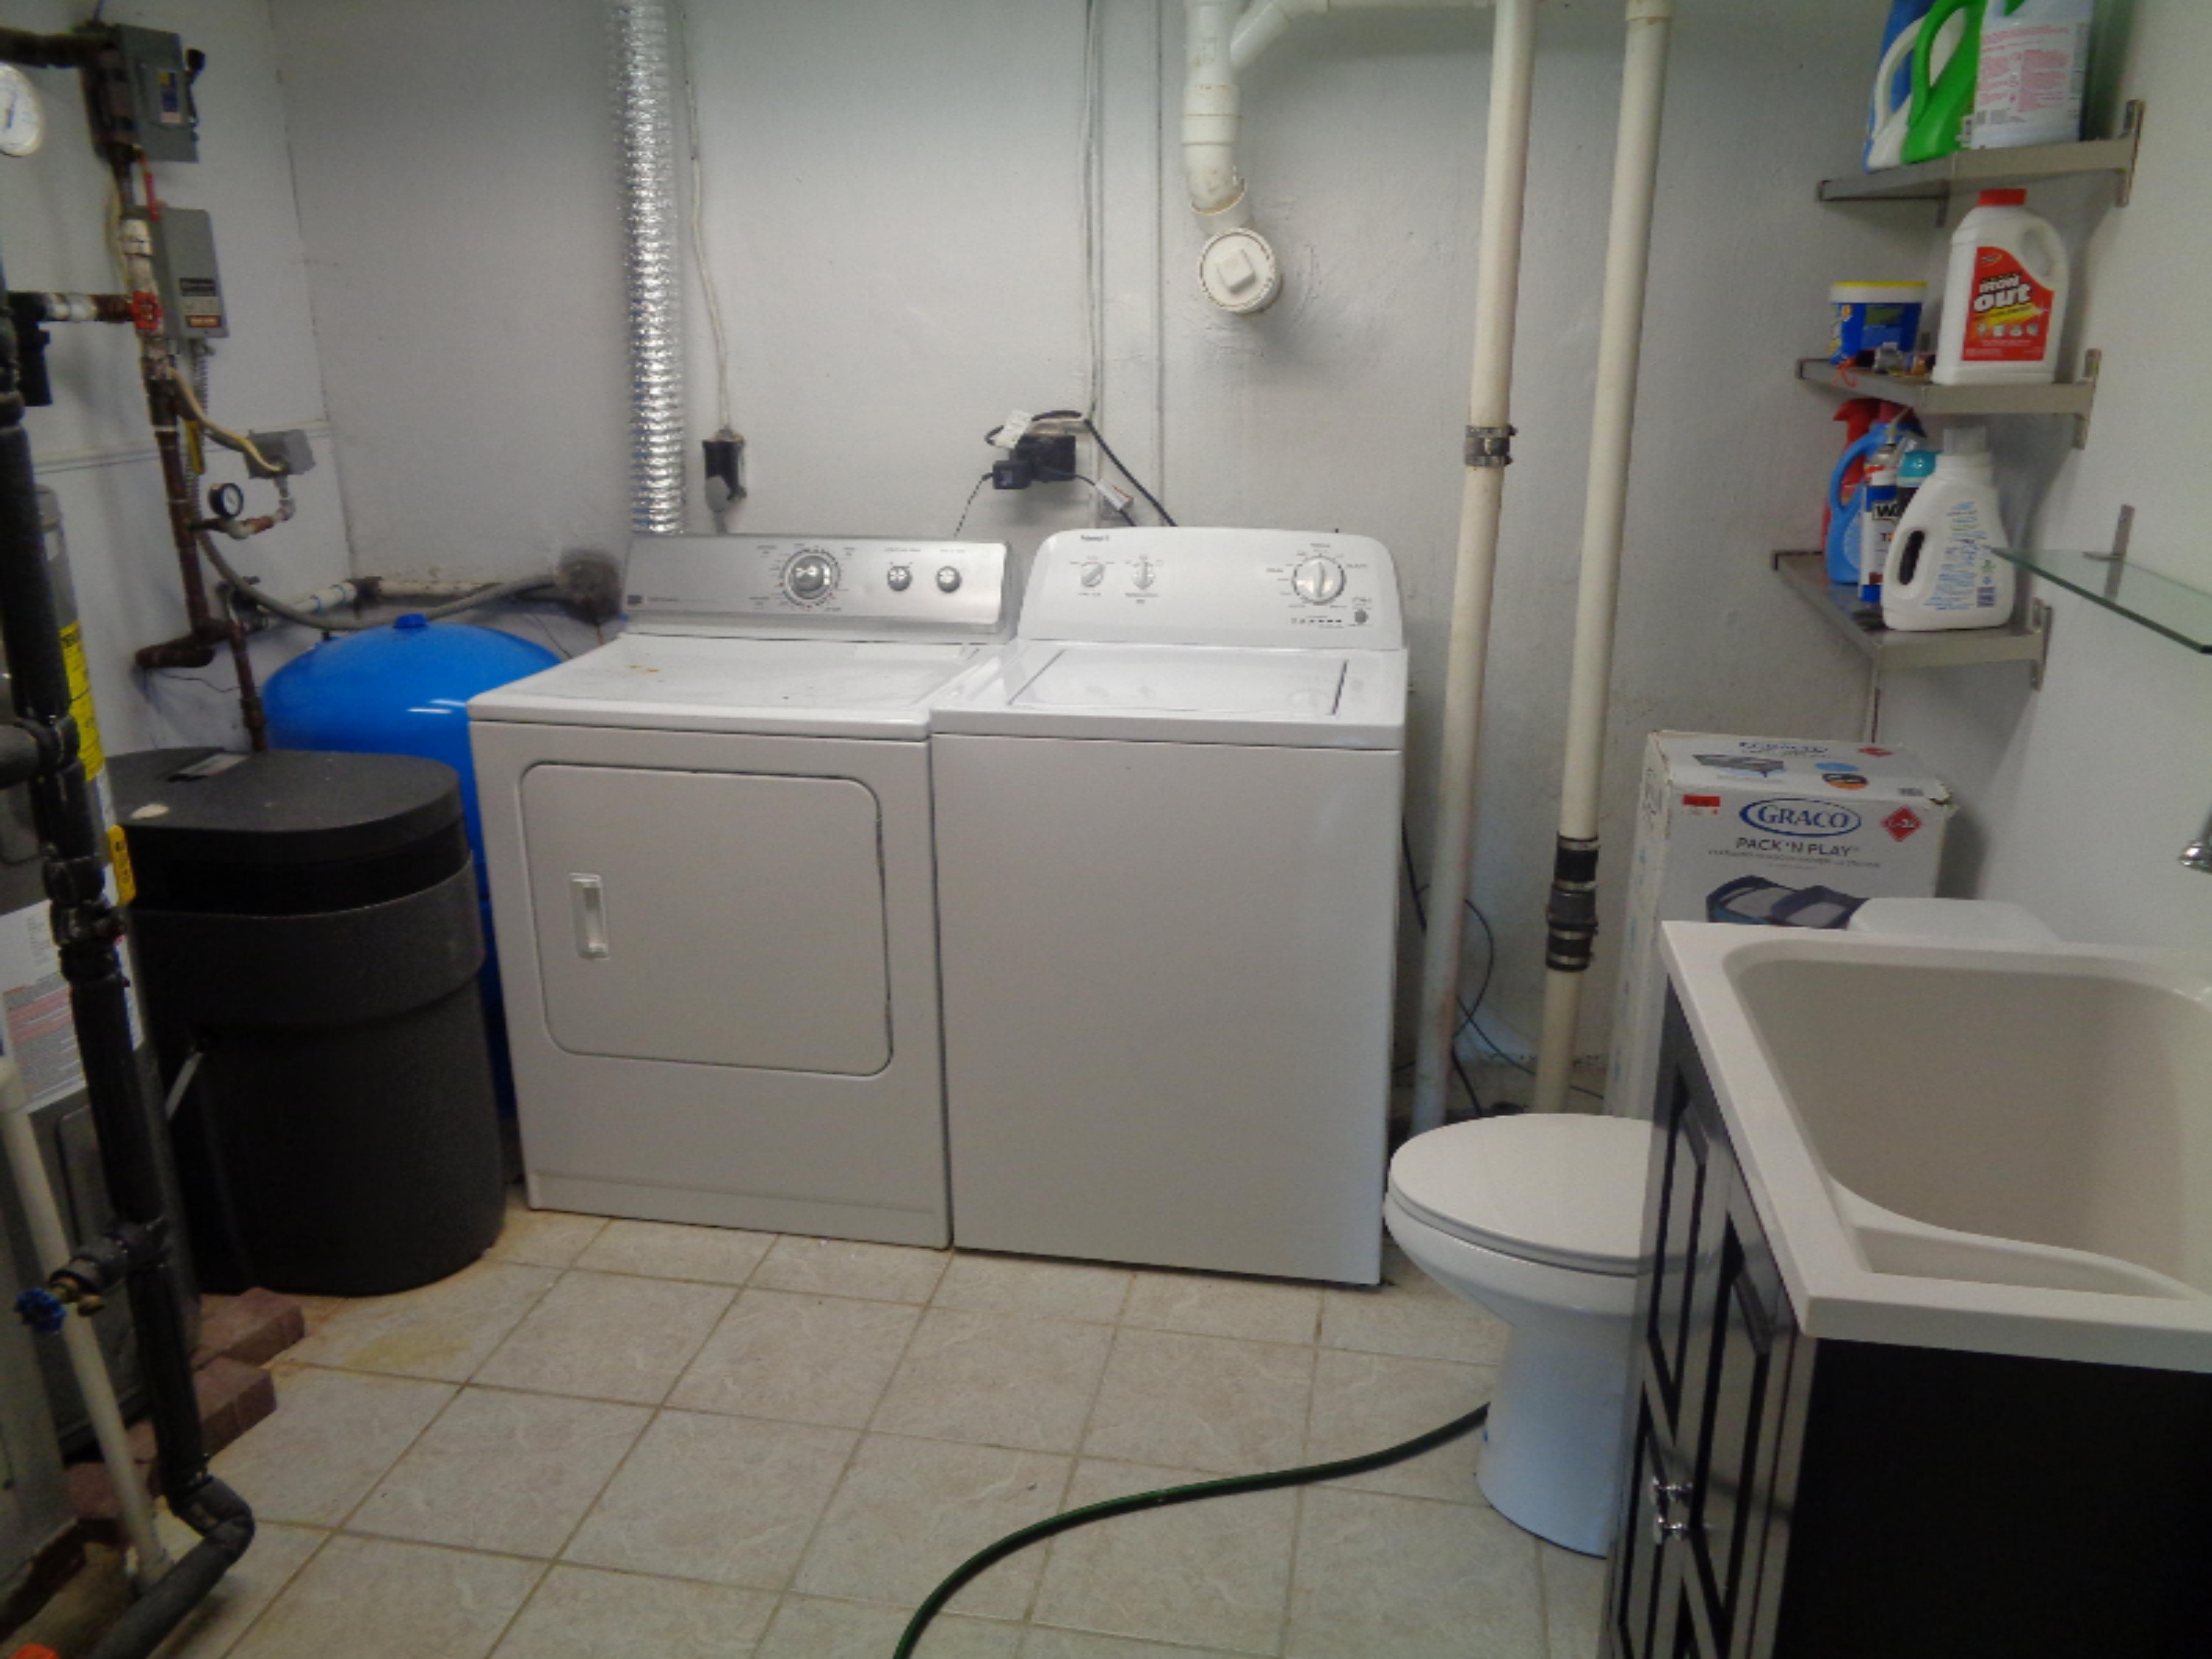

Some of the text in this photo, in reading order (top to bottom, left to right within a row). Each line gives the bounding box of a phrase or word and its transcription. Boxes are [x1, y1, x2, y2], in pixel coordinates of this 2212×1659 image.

[1757, 804, 1850, 829] GRACO
[1736, 837, 1781, 852] PACK
[1807, 844, 1852, 857] PLAY
